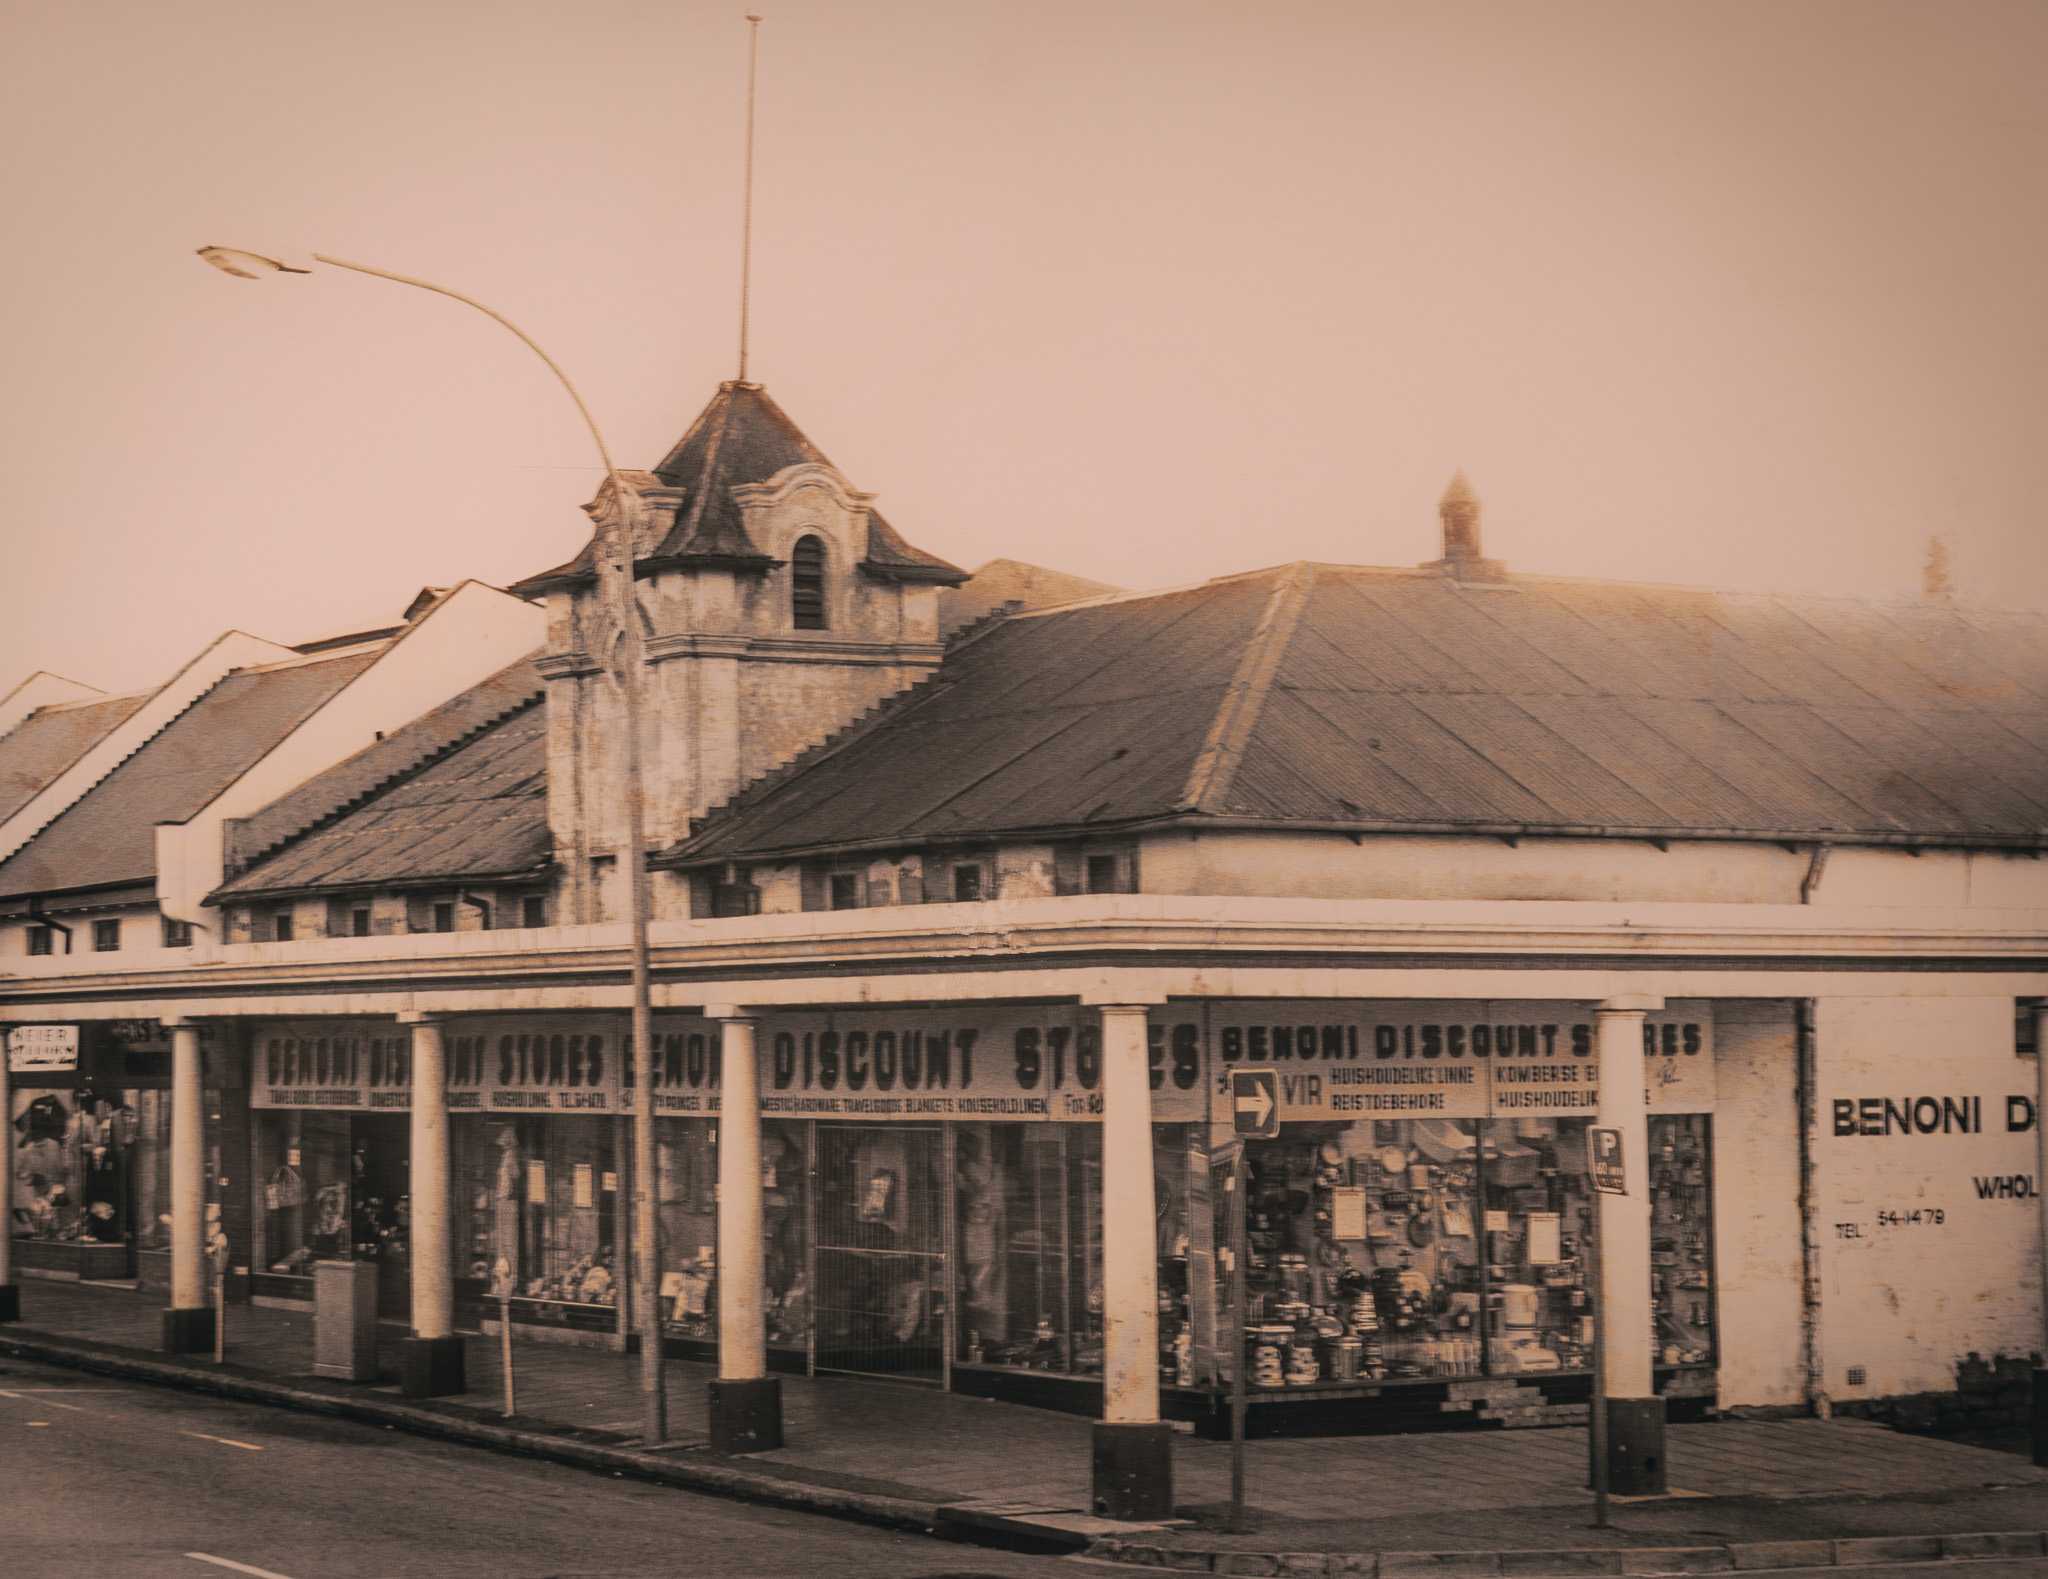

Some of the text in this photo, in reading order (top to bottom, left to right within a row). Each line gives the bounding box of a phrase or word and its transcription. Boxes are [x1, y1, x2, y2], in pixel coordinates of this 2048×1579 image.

[775, 1028, 978, 1090] DISCOUNT
[1015, 1025, 1199, 1090] STOES
[1222, 1023, 1702, 1061] BENONI DISCOUNT SRES
[1281, 1074, 1322, 1105] VIR
[1833, 1096, 1981, 1137] BENONI
[1600, 1132, 1617, 1157] P
